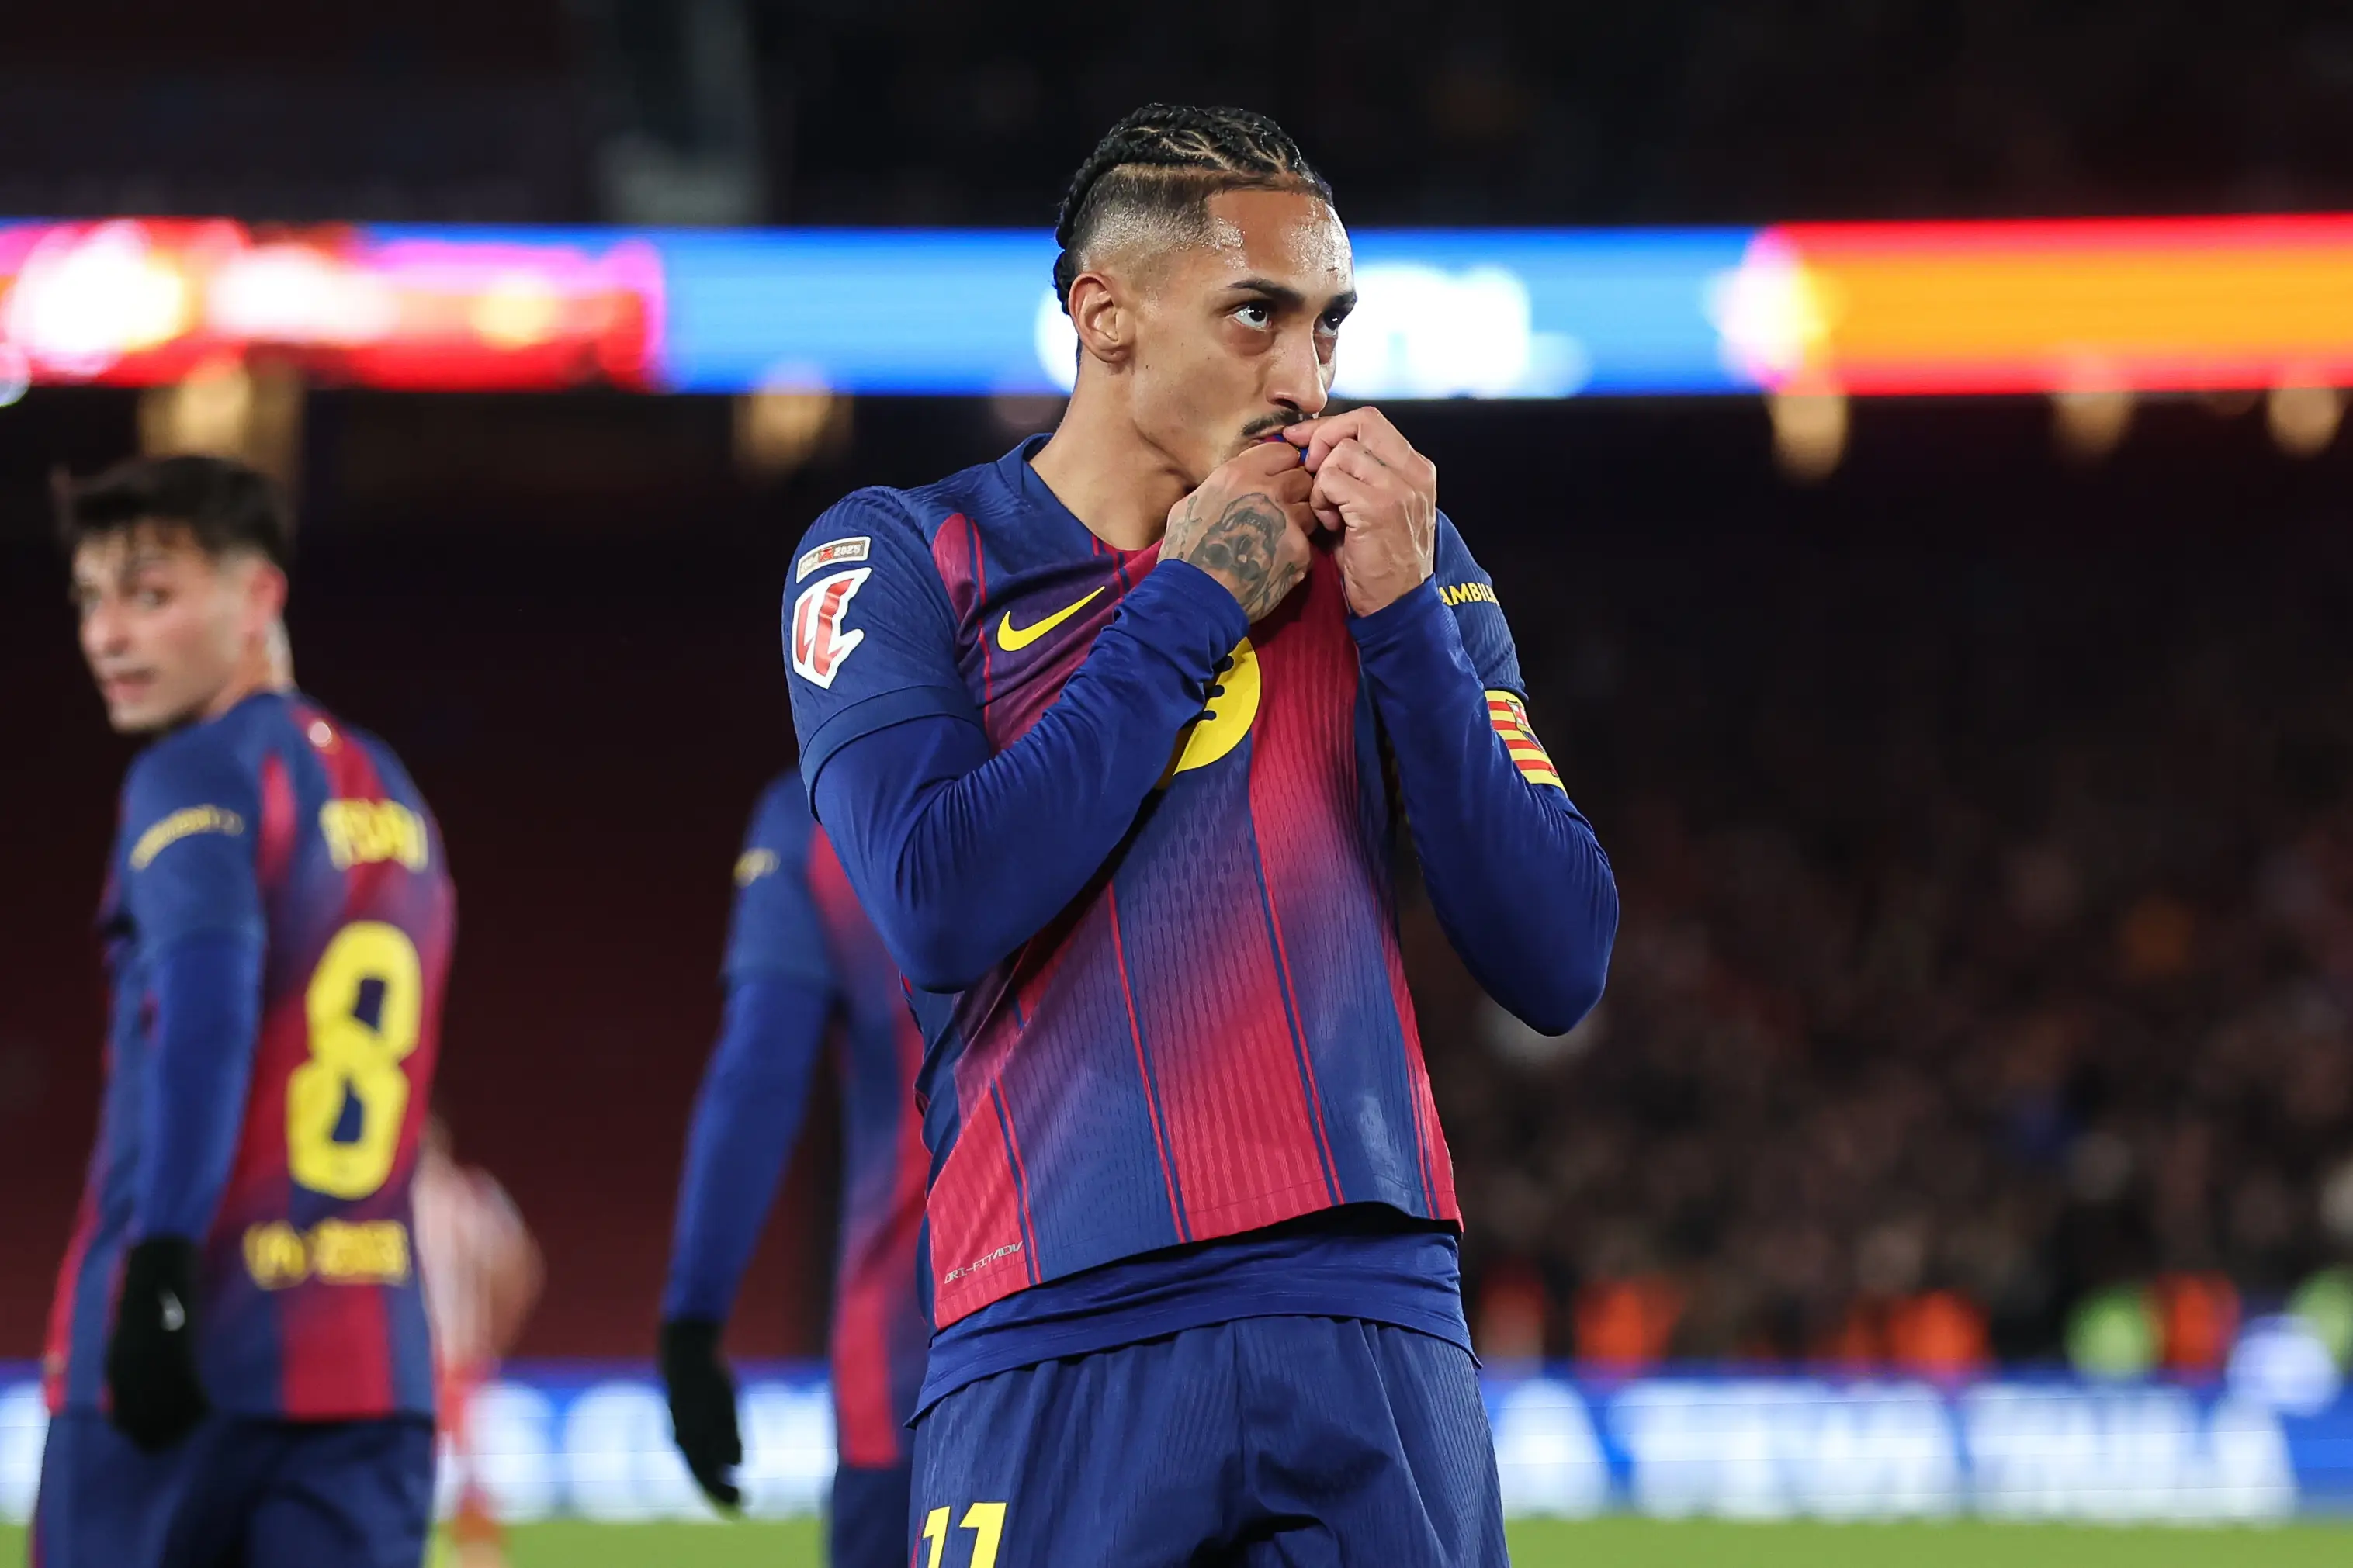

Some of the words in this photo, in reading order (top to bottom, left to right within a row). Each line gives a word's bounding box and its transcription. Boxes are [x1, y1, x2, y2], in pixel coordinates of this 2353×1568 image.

[833, 545, 861, 556] 2025
[286, 920, 423, 1200] 8
[922, 1502, 1007, 1568] 11
